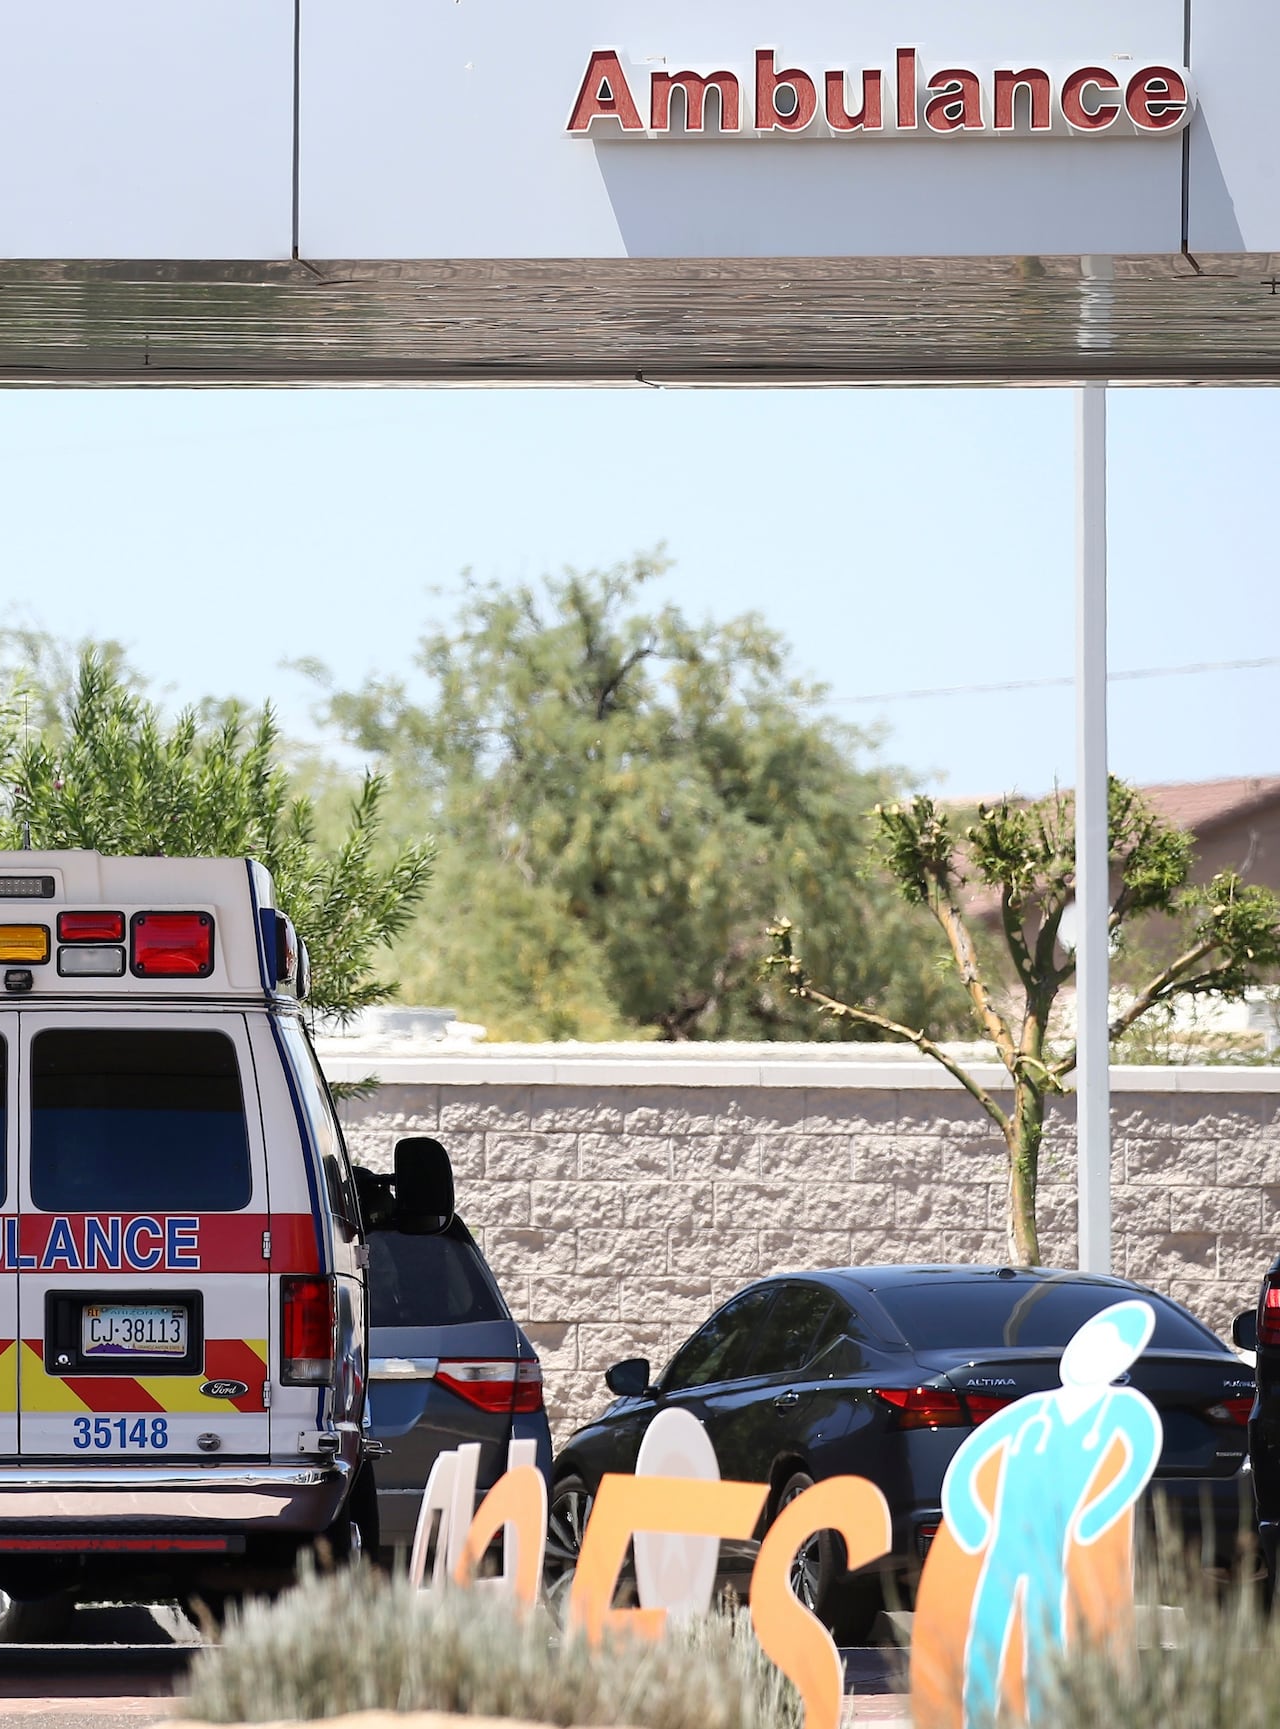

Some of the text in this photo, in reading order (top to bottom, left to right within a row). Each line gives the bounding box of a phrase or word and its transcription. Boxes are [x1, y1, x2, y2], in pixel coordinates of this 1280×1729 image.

[566, 46, 1190, 132] Ambulance
[211, 1382, 237, 1394] Ford
[966, 1378, 1017, 1386] ALTIMA
[73, 1418, 168, 1449] 35148
